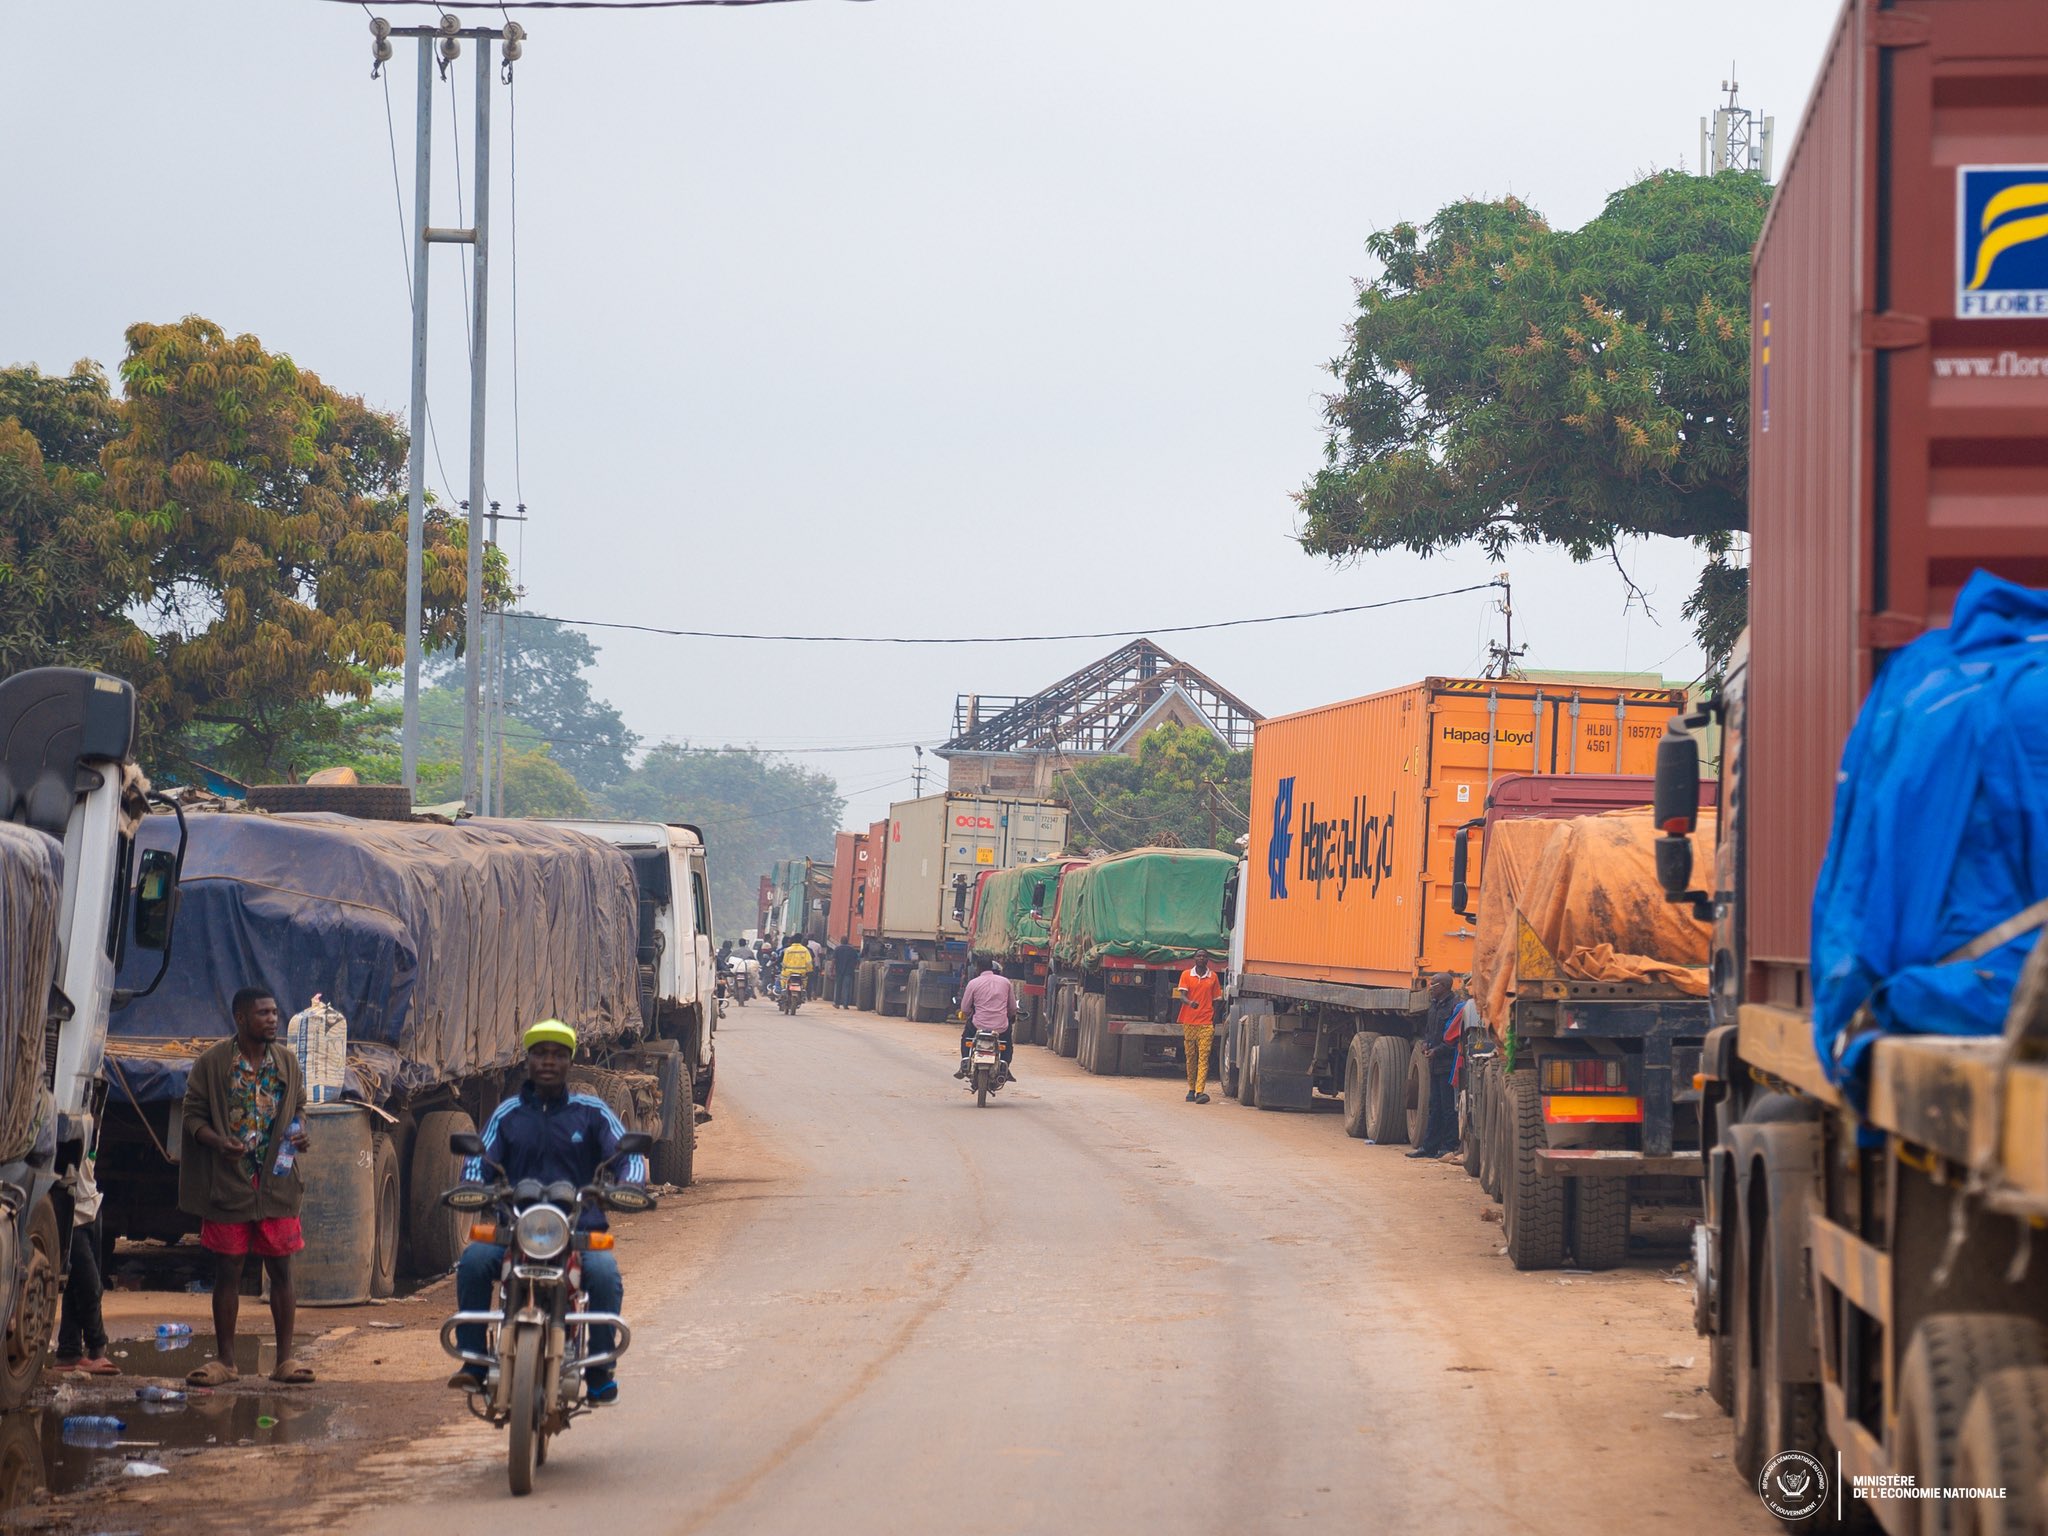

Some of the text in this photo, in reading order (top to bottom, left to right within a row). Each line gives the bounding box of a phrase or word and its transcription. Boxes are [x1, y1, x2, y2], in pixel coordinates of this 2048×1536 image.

[1586, 723, 1662, 739] HLBU 185773
[1586, 740, 1610, 752] 45G1
[955, 815, 995, 829] OOCL
